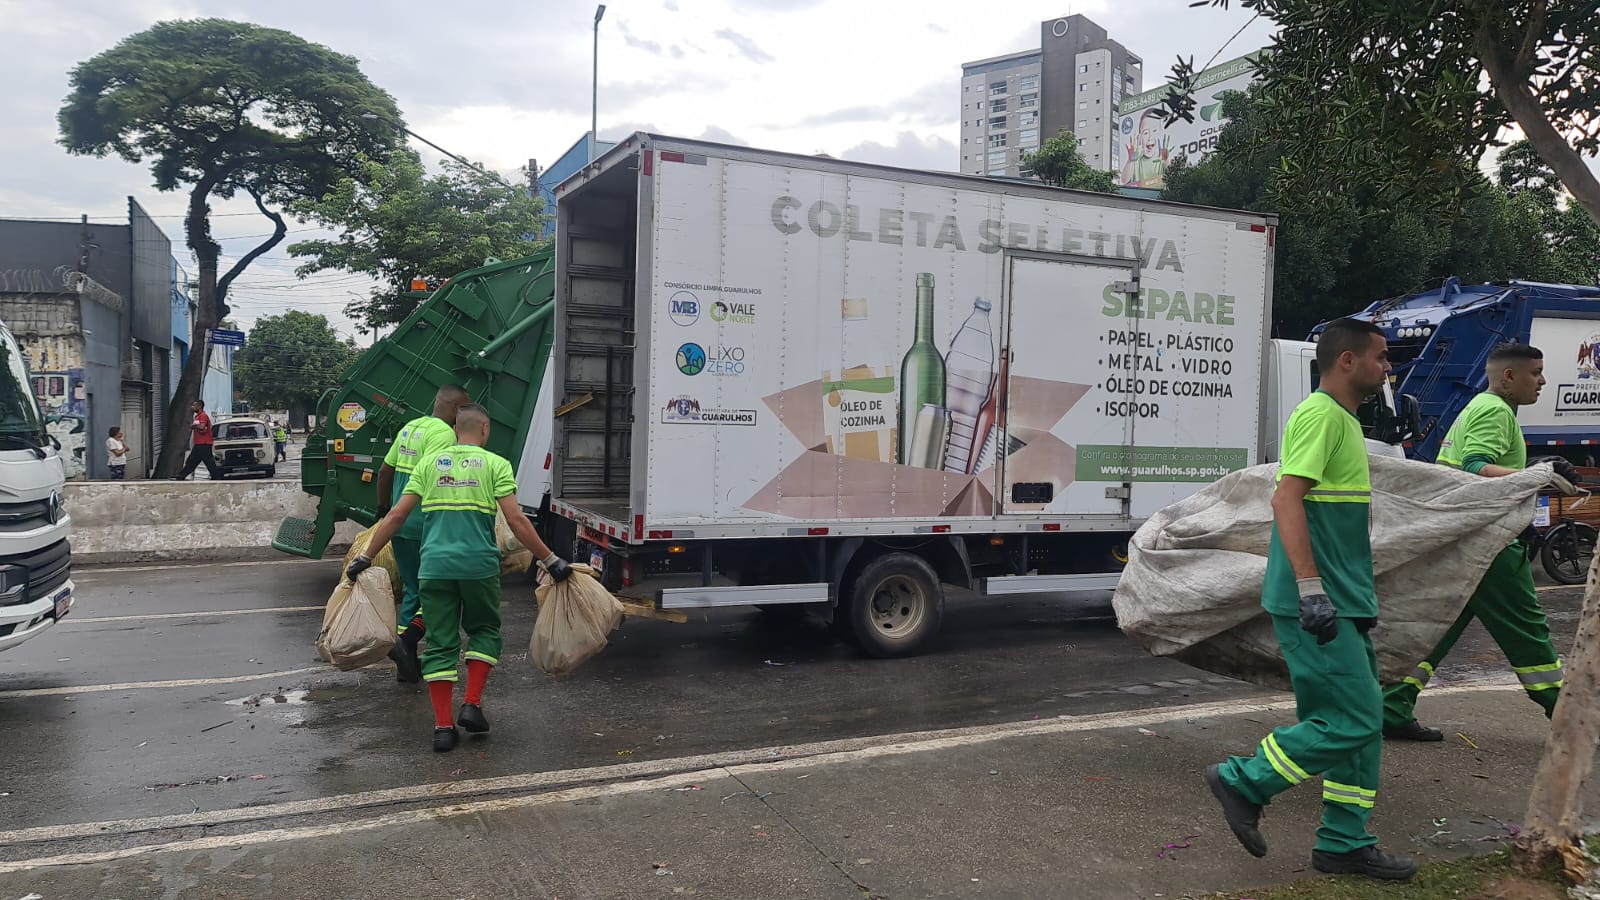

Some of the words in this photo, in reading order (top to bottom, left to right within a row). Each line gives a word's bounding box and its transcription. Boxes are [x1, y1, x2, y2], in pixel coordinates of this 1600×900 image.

[771, 196, 967, 251] COLETA
[978, 219, 1184, 272] SELETIVA
[664, 281, 702, 290] CONSÓRCIO
[724, 286, 763, 295] GUARULHOS
[671, 300, 698, 314] MB
[730, 303, 756, 316] VALE
[1101, 283, 1236, 326] SEPARE
[729, 315, 756, 324] NORTE
[1108, 329, 1155, 348] PAPEL
[1166, 331, 1234, 353] PLÁSTICO
[707, 360, 745, 374] ZERO
[1108, 353, 1164, 372] METAL
[1181, 357, 1232, 376] VIDRO
[1106, 373, 1146, 394] ÓLEO
[1149, 379, 1169, 396] DE
[1172, 381, 1233, 399] COZINHA
[840, 399, 867, 412] ÓLEO
[869, 400, 883, 411] DE
[1105, 401, 1160, 418] ISOPOR
[701, 413, 753, 422] GUARULHOS
[840, 415, 886, 427] COZINHA
[1100, 465, 1230, 478] www.guarulhos.sp.gov.br
